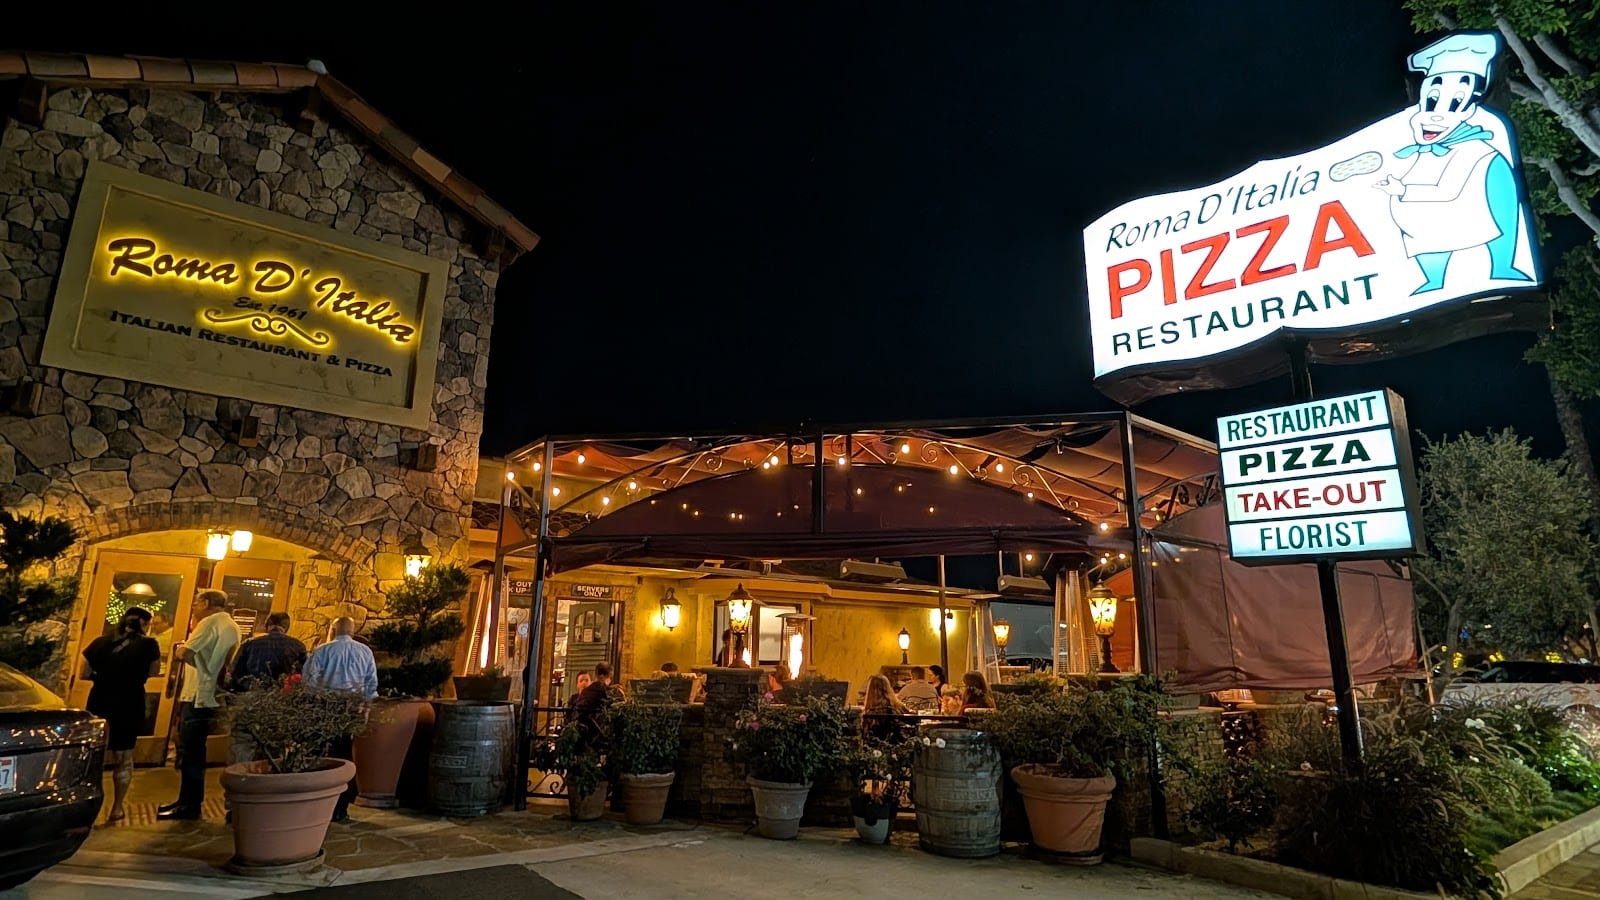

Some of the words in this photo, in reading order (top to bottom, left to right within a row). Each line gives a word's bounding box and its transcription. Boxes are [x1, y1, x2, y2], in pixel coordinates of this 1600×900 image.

[1105, 210, 1191, 252] Roma
[1197, 165, 1320, 224] D'Italia
[108, 237, 240, 285] Roma
[1106, 199, 1376, 319] PIZZA
[1112, 272, 1380, 356] RESTAURANT
[109, 310, 192, 337] ITALIAN
[198, 327, 321, 363] RESTAURANT
[326, 354, 340, 367] &
[345, 357, 393, 377] PIZZA
[1226, 395, 1377, 442] RESTAURANT
[1238, 439, 1372, 477] PIZZA
[1237, 479, 1387, 513] TAKE-OUT
[1259, 520, 1368, 551] FLORIST
